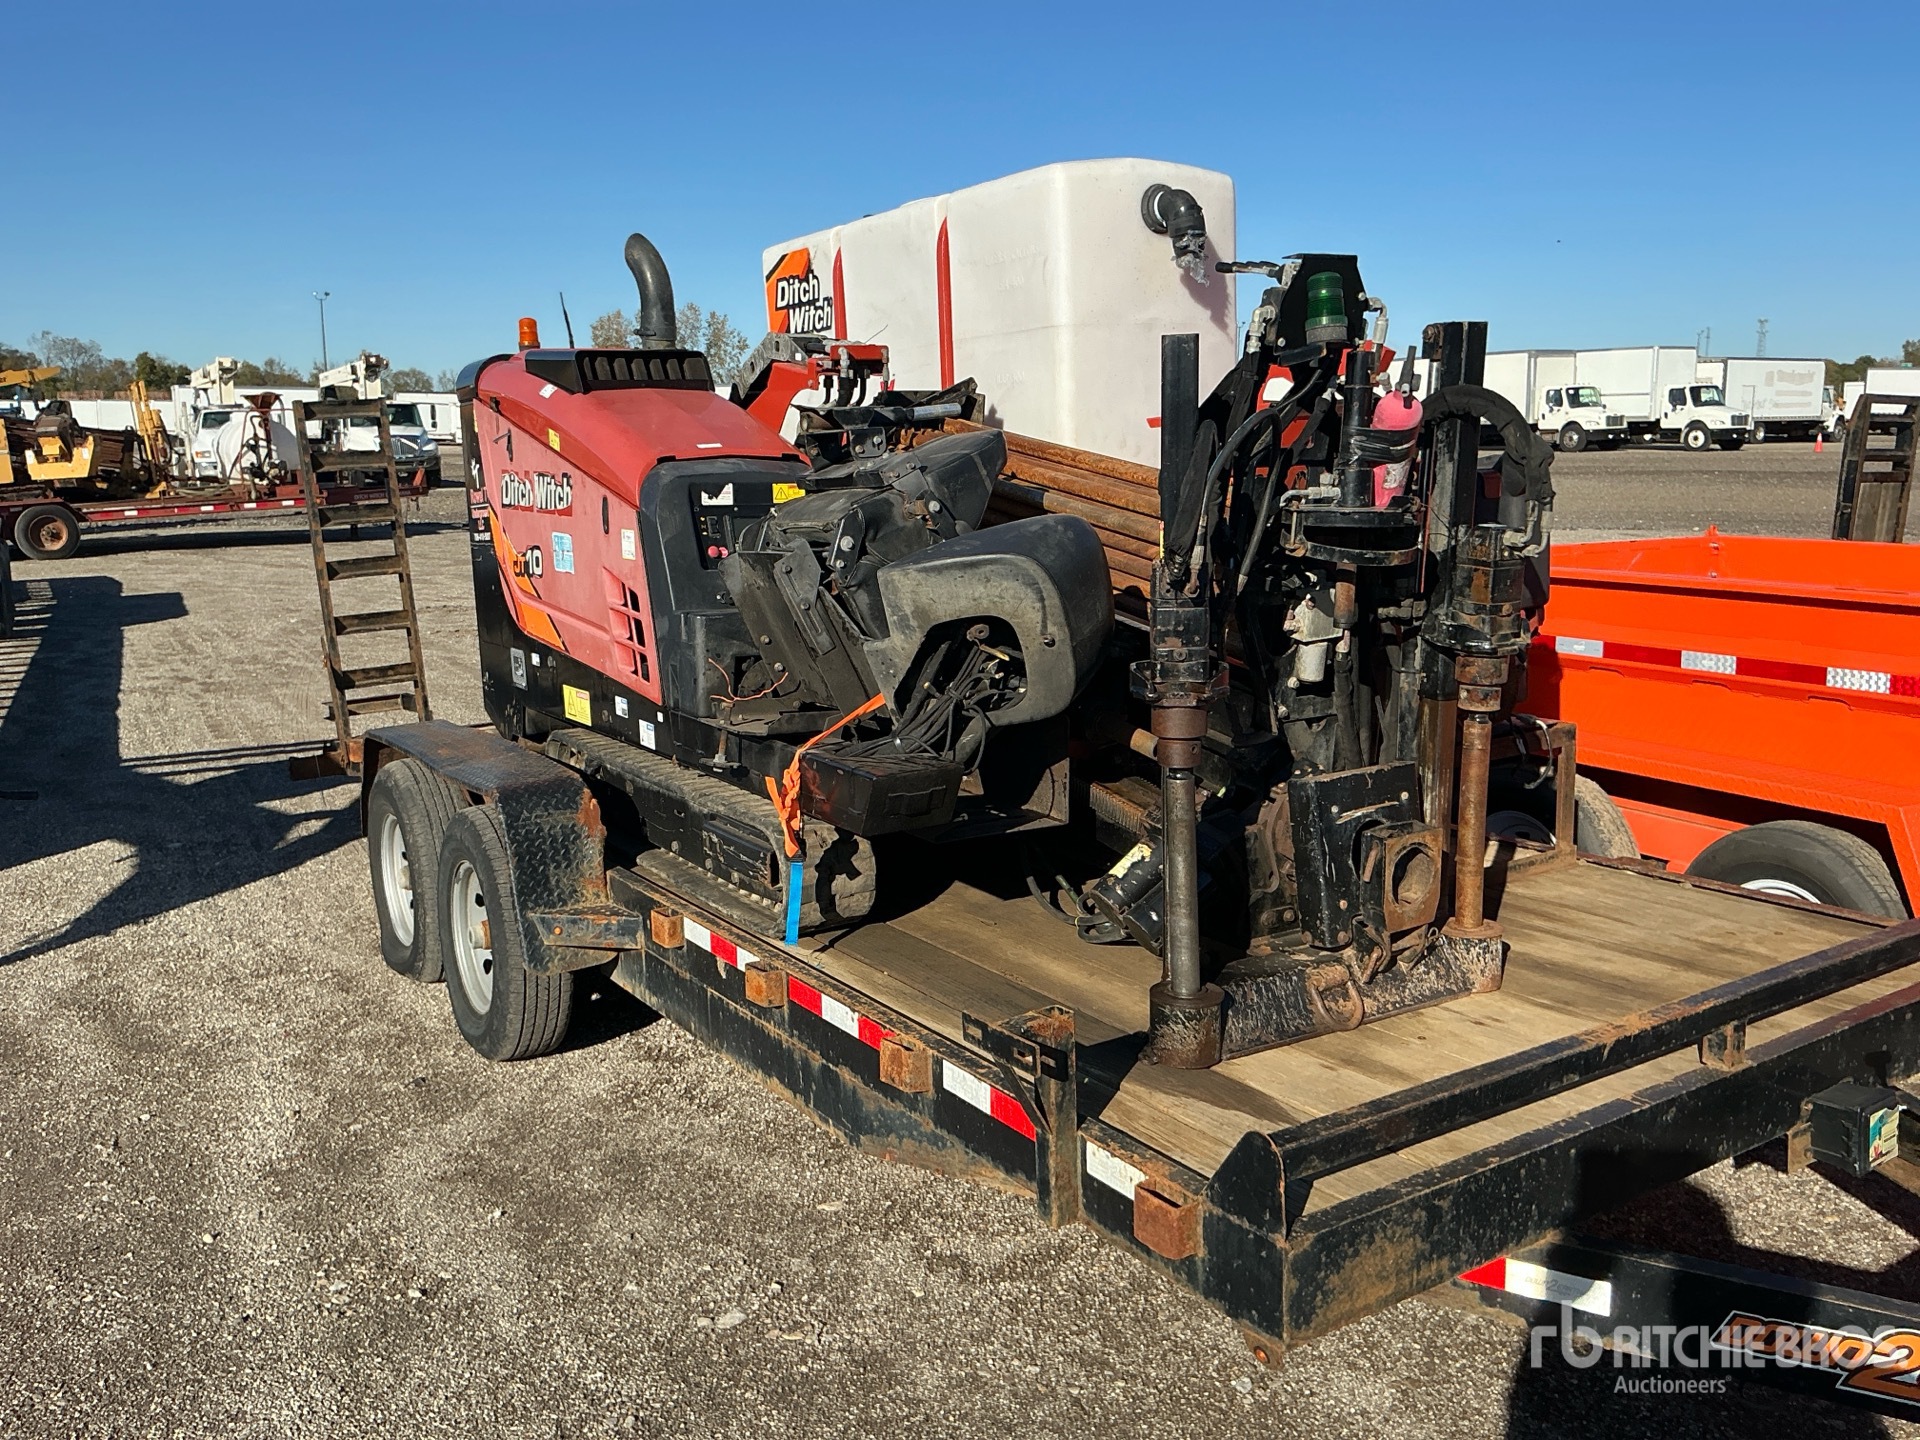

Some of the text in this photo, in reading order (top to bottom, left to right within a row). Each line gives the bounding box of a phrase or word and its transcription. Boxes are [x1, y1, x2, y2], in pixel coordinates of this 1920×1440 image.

[776, 271, 819, 310] Ditch
[788, 299, 832, 334] Witch
[501, 472, 533, 508] Ditch
[534, 472, 572, 510] Witch
[513, 545, 543, 578] JT10
